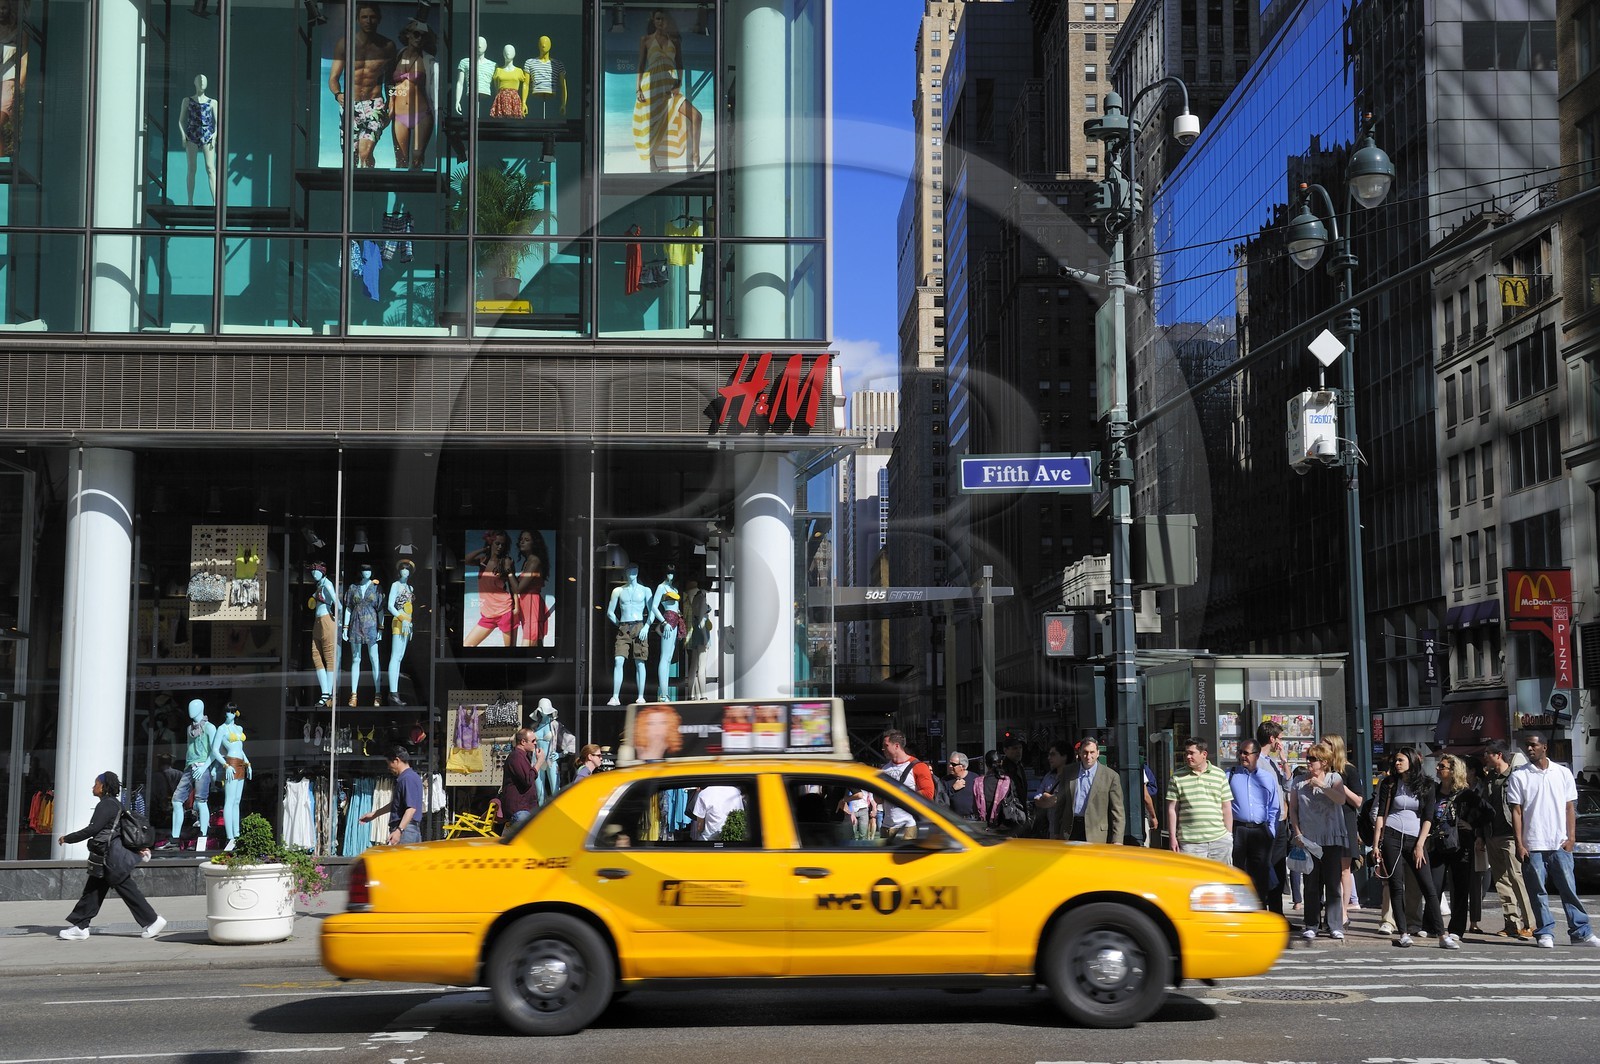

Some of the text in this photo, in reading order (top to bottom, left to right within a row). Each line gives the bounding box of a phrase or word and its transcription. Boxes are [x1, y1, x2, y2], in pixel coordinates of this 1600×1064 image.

[718, 352, 830, 428] H&M
[982, 464, 1072, 483] Fifth Ave
[864, 590, 924, 600] 505 FIFTH
[1425, 639, 1435, 678] NAILS
[1557, 624, 1569, 682] PIZZA
[1198, 674, 1208, 725] Newsstand
[815, 893, 864, 911] NYC
